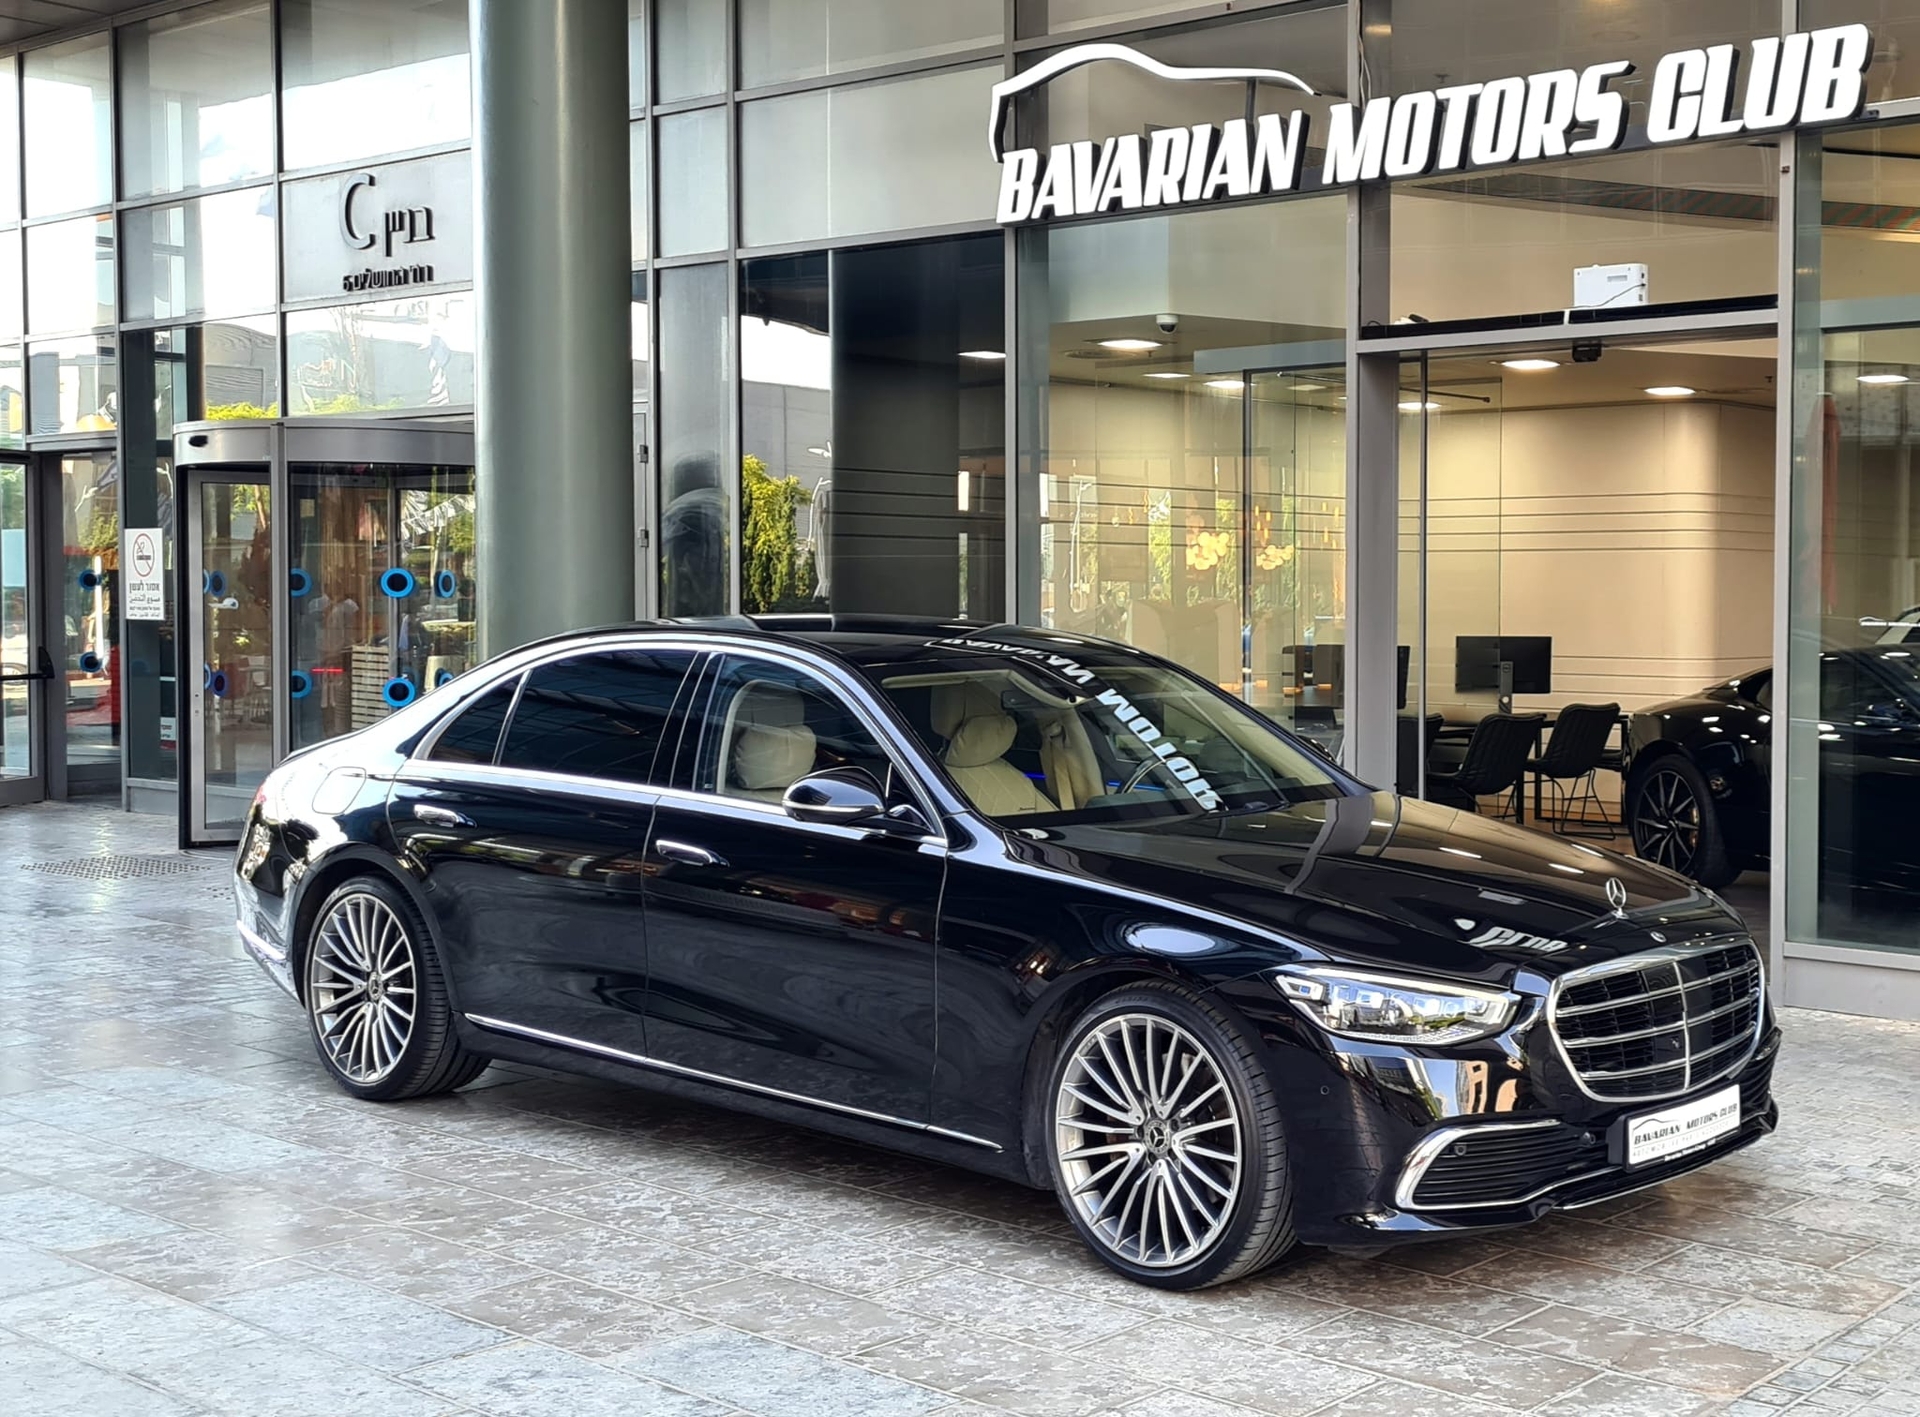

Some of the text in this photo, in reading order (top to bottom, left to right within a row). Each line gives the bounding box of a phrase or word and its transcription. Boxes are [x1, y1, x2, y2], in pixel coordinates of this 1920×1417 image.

[995, 23, 1871, 224] BAVARIAN MOTORS CLUB
[339, 172, 376, 251] C
[129, 579, 145, 594] לעשן
[1633, 1124, 1681, 1146] BAVARIAN
[1686, 1110, 1719, 1130] MOTORS
[1719, 1103, 1738, 1118] CLUB
